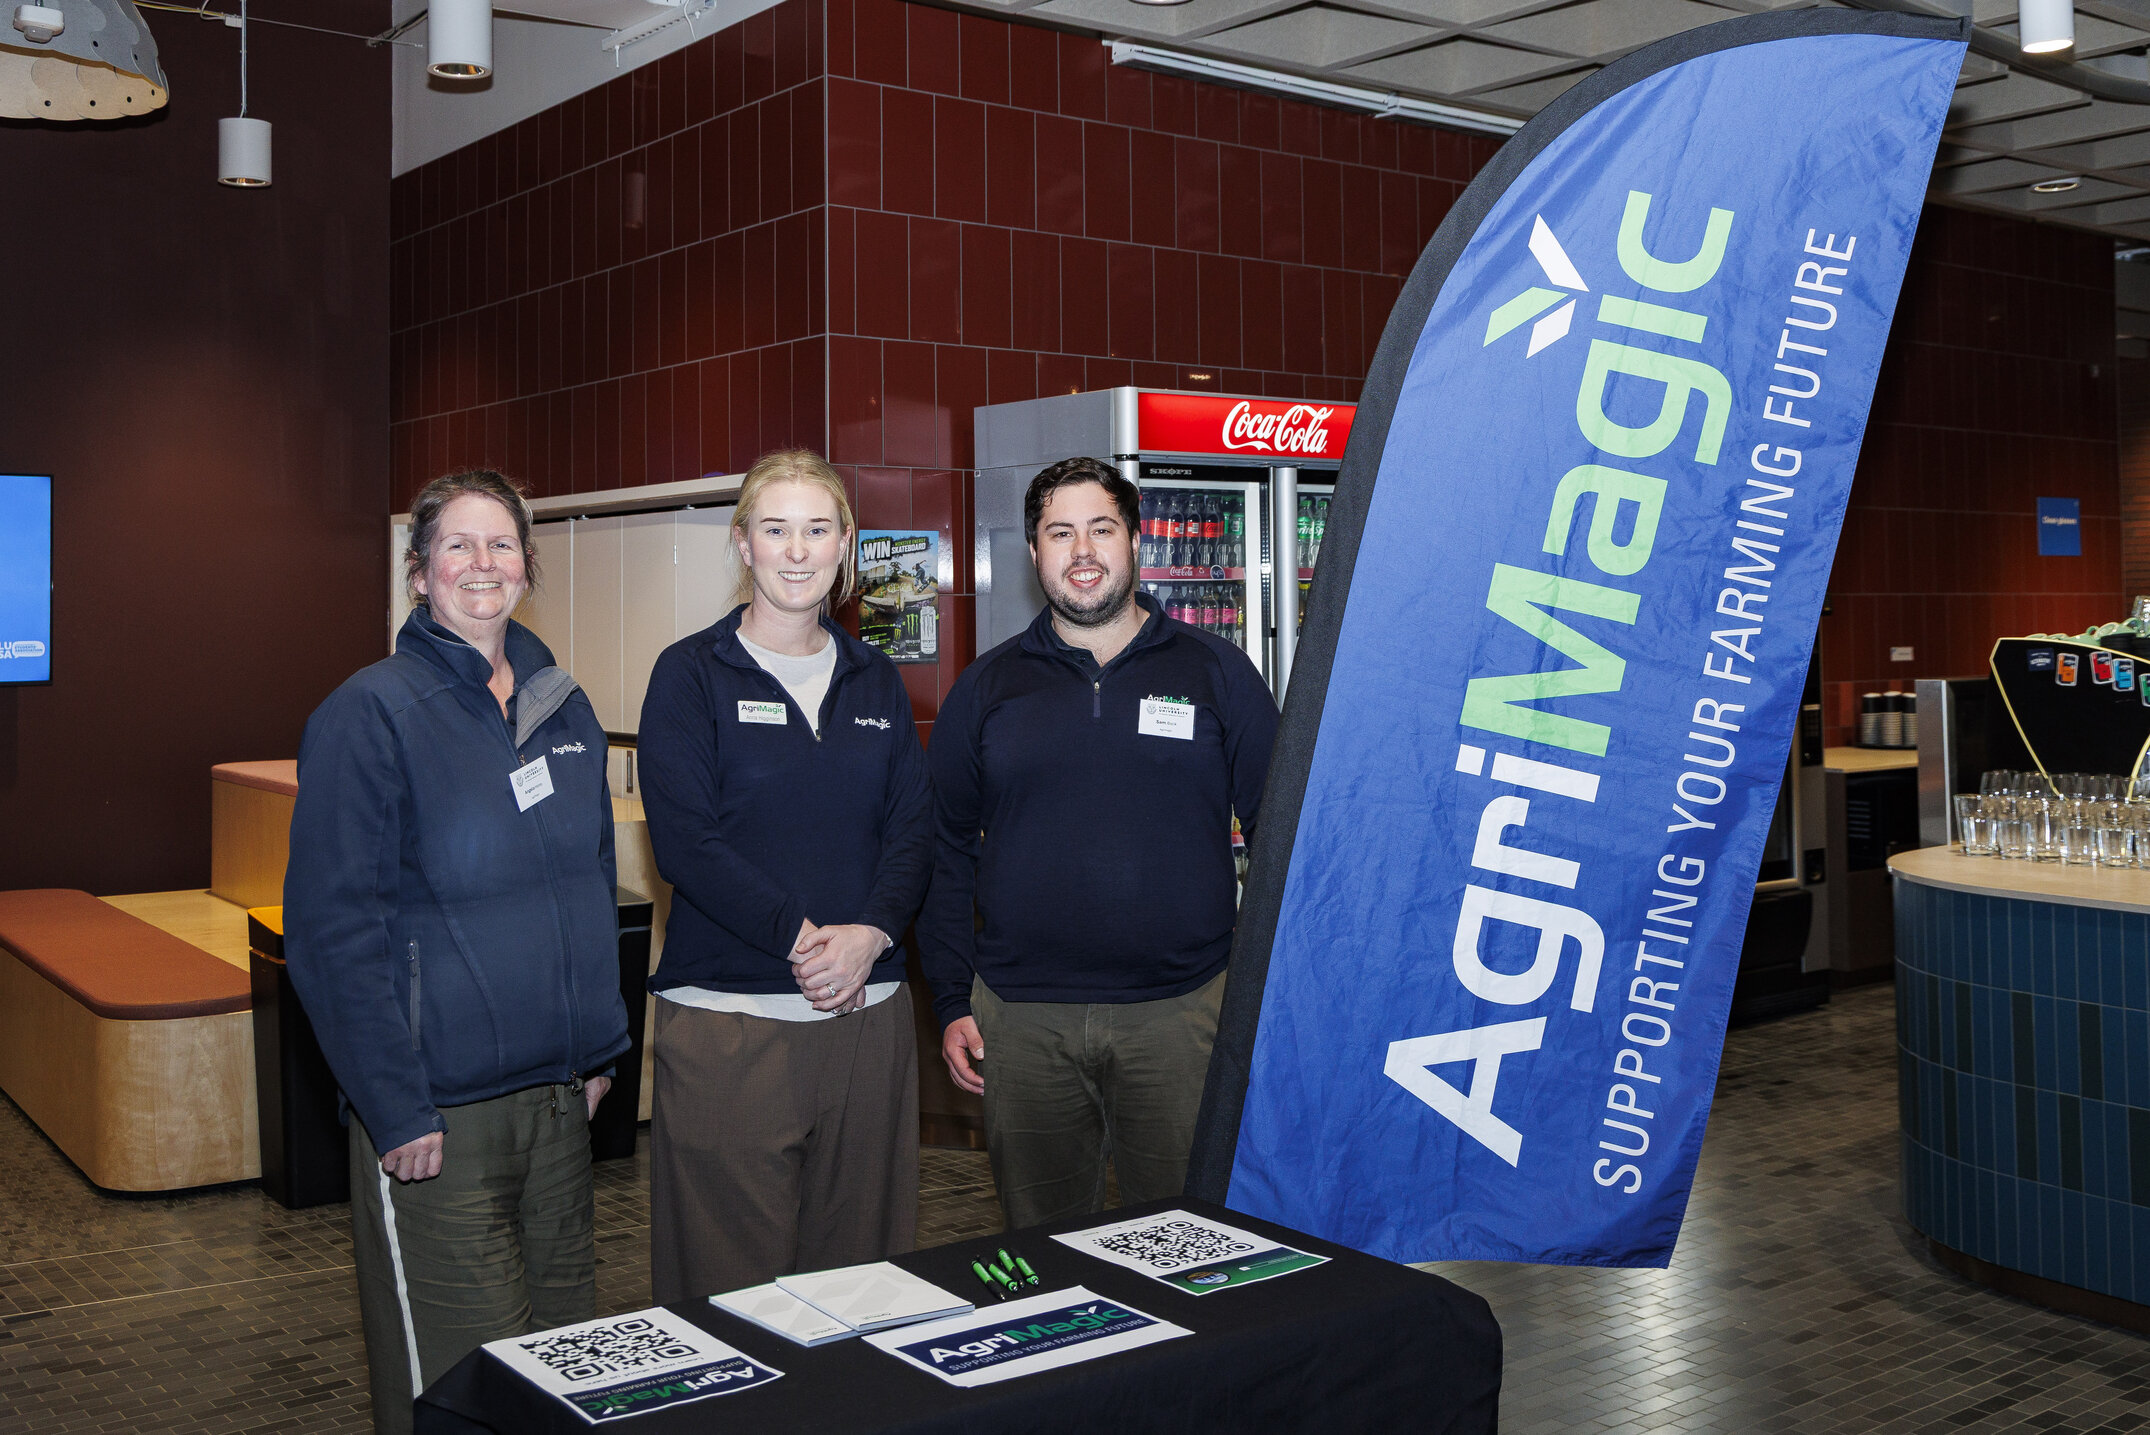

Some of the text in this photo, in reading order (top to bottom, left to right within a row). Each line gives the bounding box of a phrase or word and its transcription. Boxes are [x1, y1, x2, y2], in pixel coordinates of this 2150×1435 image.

[1222, 401, 1334, 453] Coca-Cola
[1150, 467, 1192, 476] SKOPE
[863, 540, 890, 560] WIN
[891, 542, 927, 555] SKATEBOARD
[1170, 566, 1193, 577] Coca-Cola
[1383, 189, 1735, 1169] AgriMagic
[741, 704, 784, 714] AgriMagic
[854, 717, 891, 730] AgriMagic
[1593, 228, 1857, 1194] SUPPORTING YOUR FARMING FUTURE
[552, 742, 587, 755] AgriMagic
[930, 1306, 1130, 1363] AgriMagic
[949, 1319, 1148, 1371] SUPPORTING YOUR FARMING FUTURE
[574, 1360, 744, 1402] SUPPORTING YOUR FARMING FUTURE
[581, 1365, 755, 1413] AgriMagic
